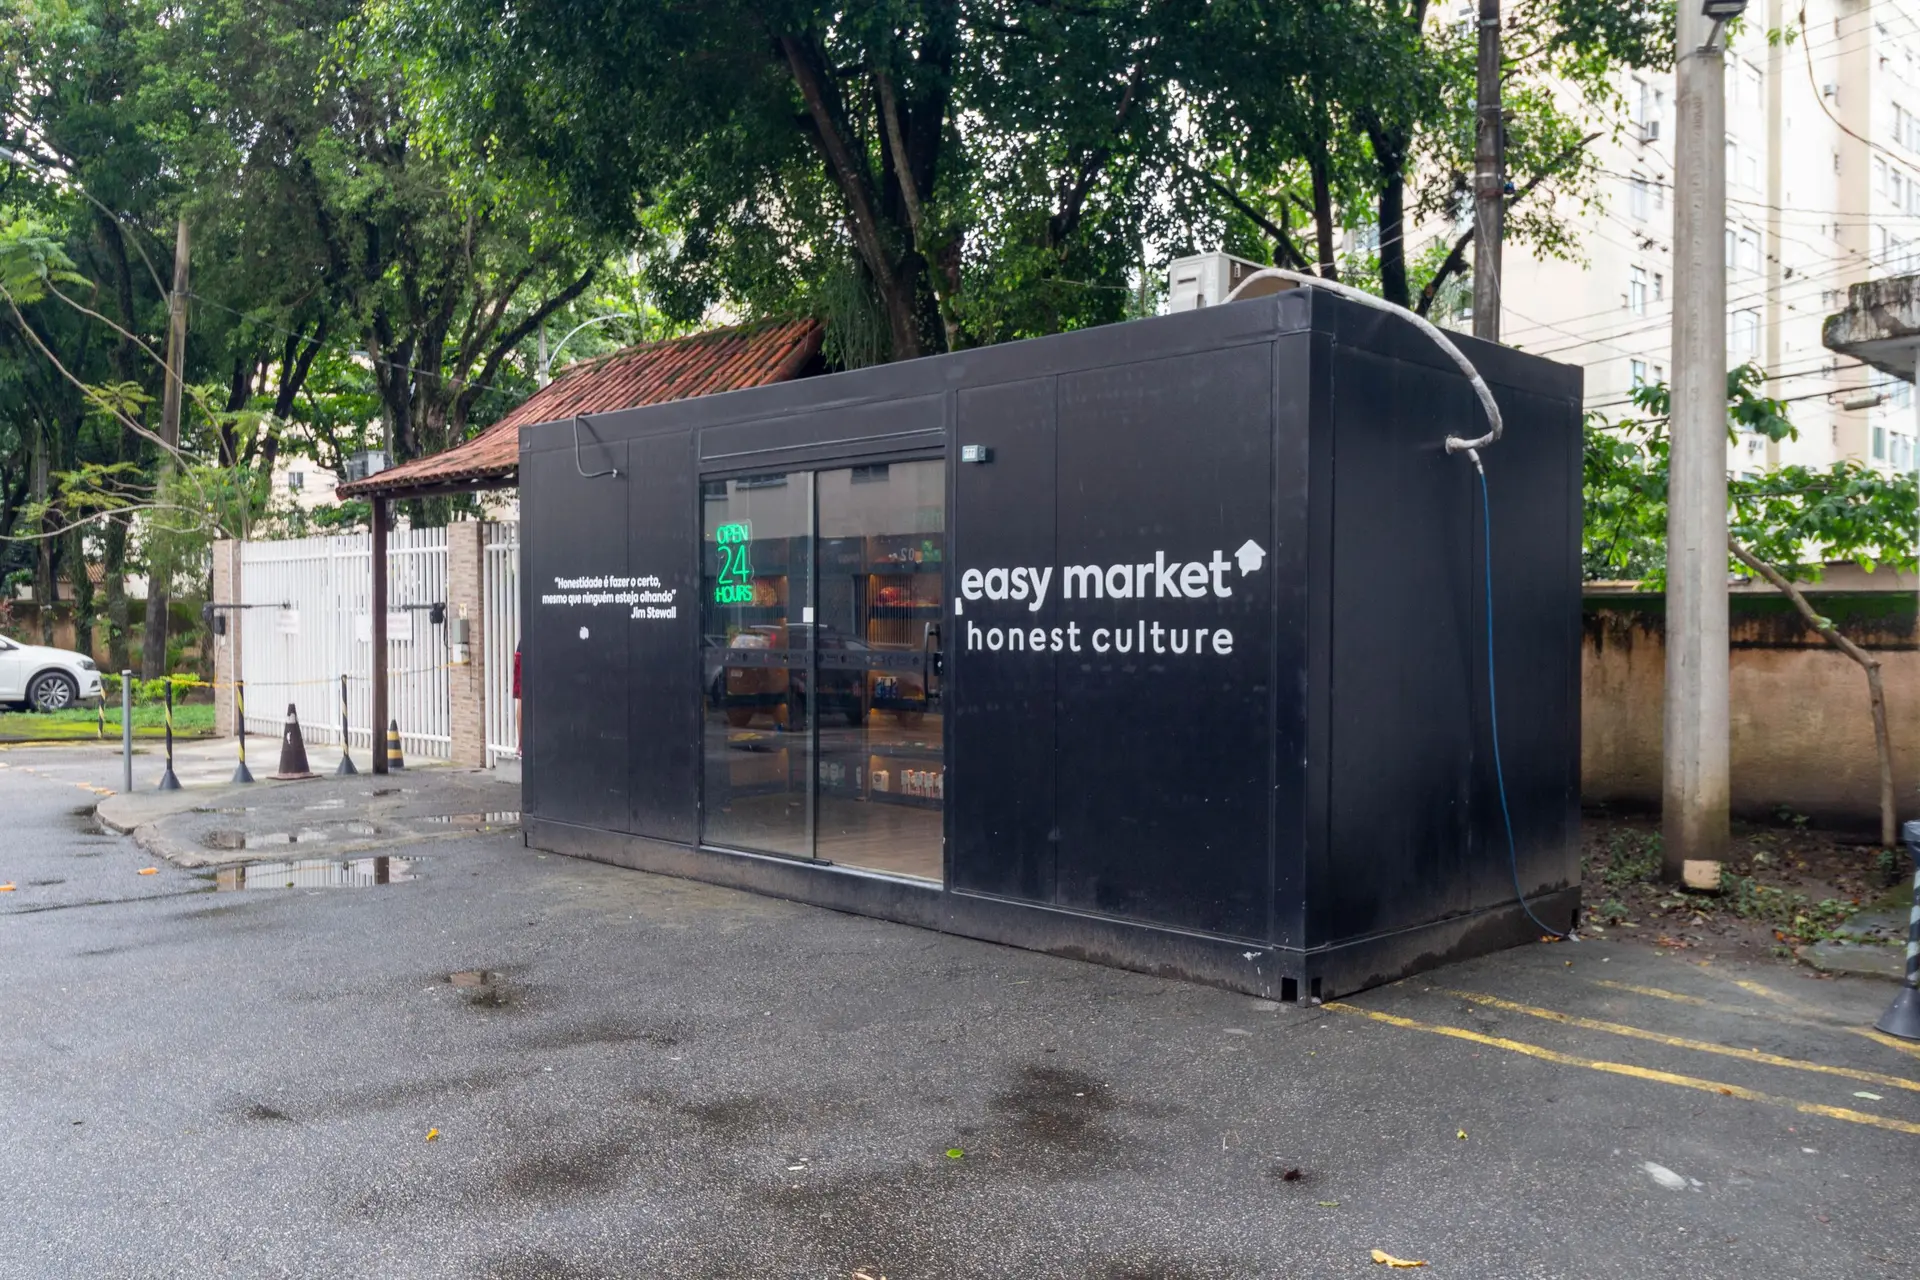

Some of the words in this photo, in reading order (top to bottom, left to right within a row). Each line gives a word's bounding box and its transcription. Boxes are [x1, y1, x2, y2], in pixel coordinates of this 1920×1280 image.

[717, 524, 748, 544] OPEN
[718, 545, 749, 584] 24
[603, 575, 609, 588] é
[609, 575, 630, 588] fazer
[630, 578, 636, 587] o
[637, 575, 661, 588] certo,
[961, 566, 1053, 612] easy
[1064, 550, 1233, 598] market
[542, 594, 567, 604] mesmo
[568, 594, 582, 606] que
[583, 591, 614, 606] ninguém
[615, 591, 639, 606] esteja
[715, 584, 753, 604] HOURS
[631, 607, 646, 619] Jim
[967, 620, 1081, 652] honest
[1091, 620, 1234, 655] culture
